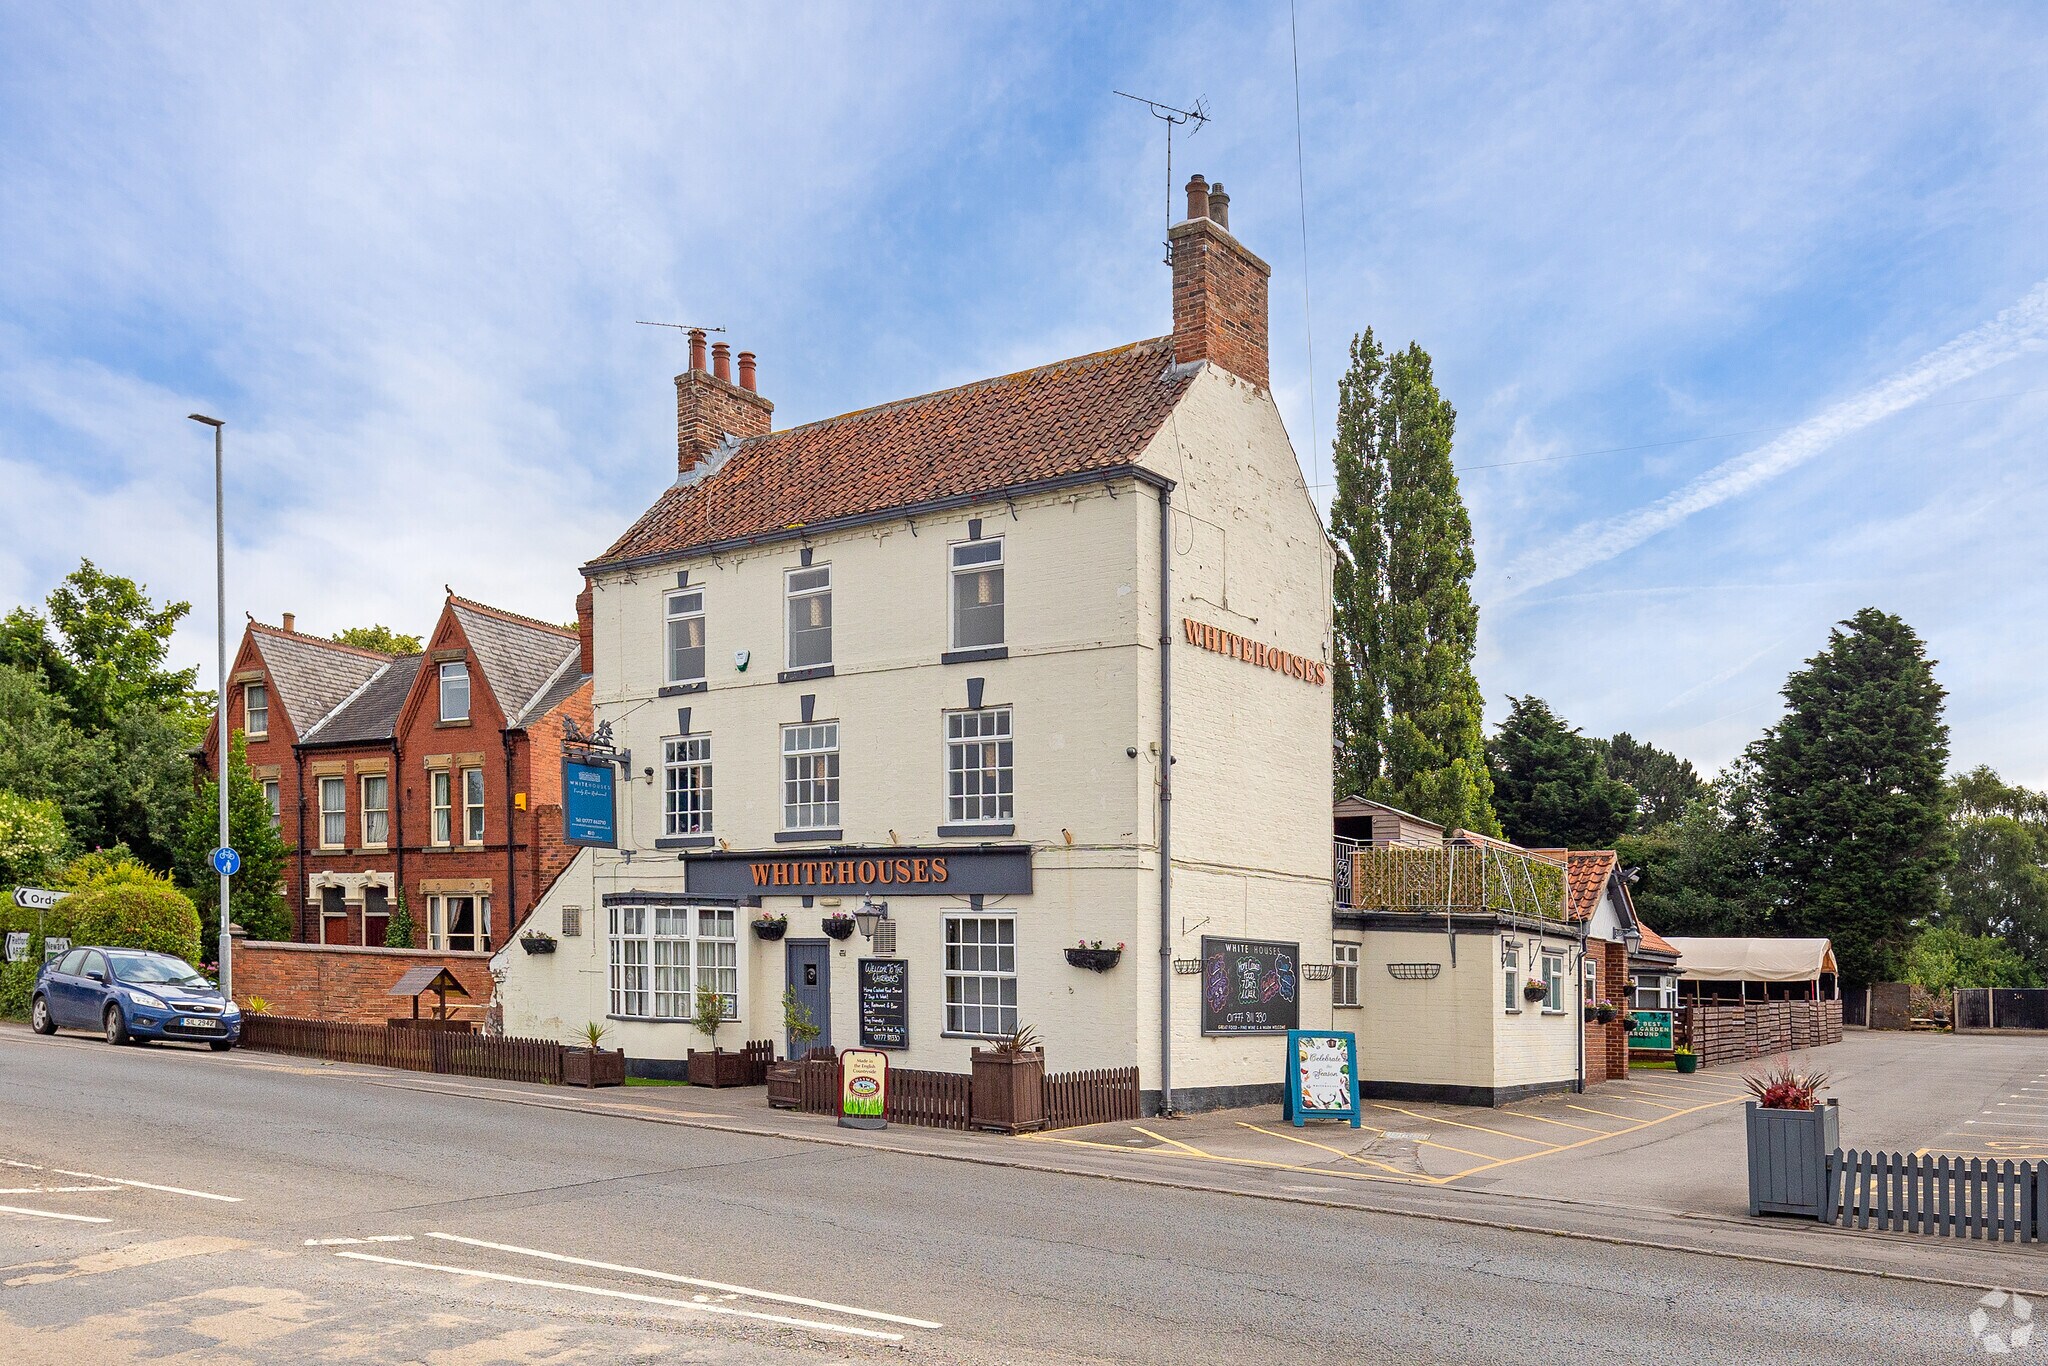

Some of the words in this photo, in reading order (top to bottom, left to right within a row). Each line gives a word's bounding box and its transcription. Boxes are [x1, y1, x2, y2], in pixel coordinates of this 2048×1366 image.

[1183, 618, 1325, 686] WHITEHOUSES
[570, 781, 610, 790] WHITEHOUSES
[750, 857, 948, 886] WHITEHOUSES
[31, 894, 59, 906] Ords
[46, 941, 66, 950] Newark
[1225, 943, 1249, 954] WHITE
[1253, 946, 1280, 956] HOUSES
[1255, 1012, 1267, 1024] 330
[1310, 1053, 1341, 1062] Celebrate
[1313, 1068, 1338, 1080] Season
